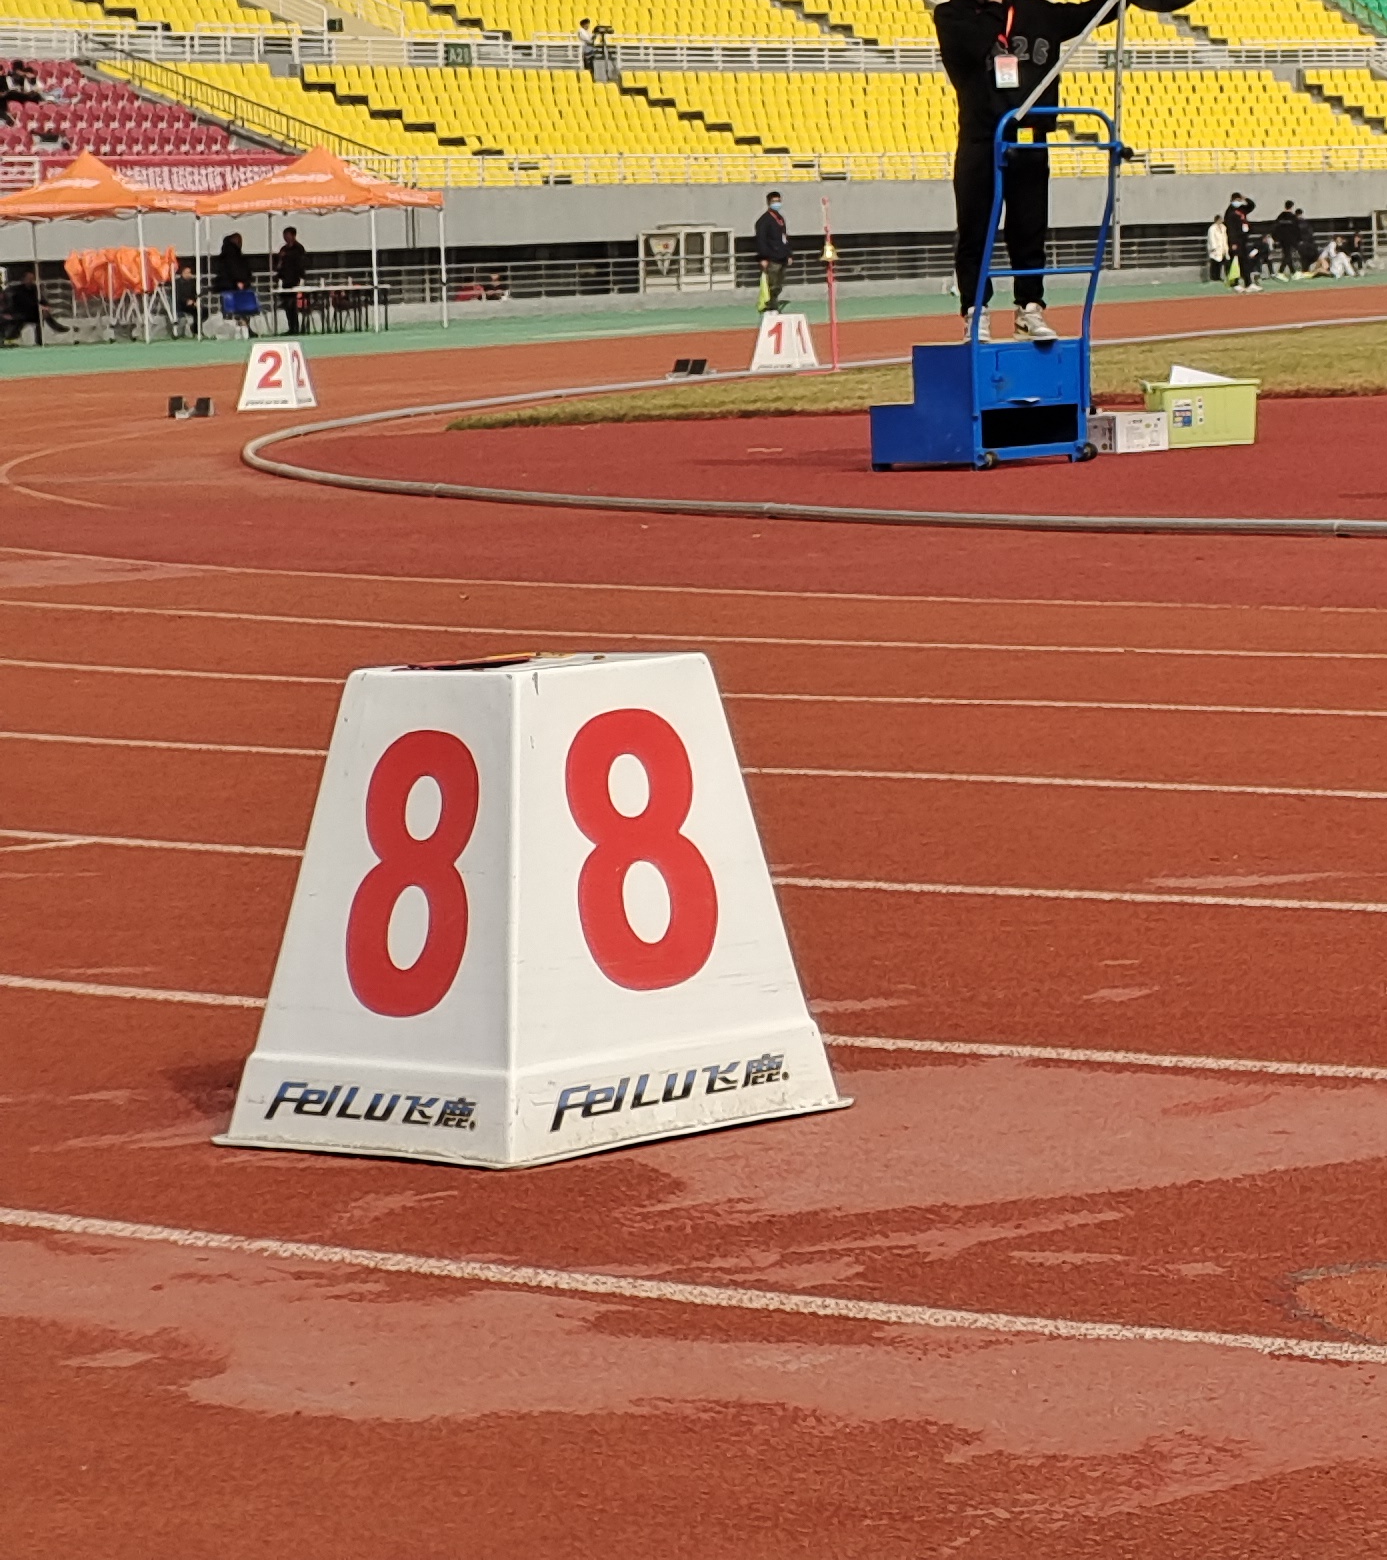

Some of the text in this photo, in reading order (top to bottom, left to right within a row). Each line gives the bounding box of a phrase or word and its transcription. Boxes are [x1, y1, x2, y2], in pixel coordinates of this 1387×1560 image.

[768, 322, 782, 355] 1
[257, 350, 283, 389] 2
[291, 349, 306, 389] 2
[565, 708, 719, 991] 8
[346, 729, 479, 1018] 8
